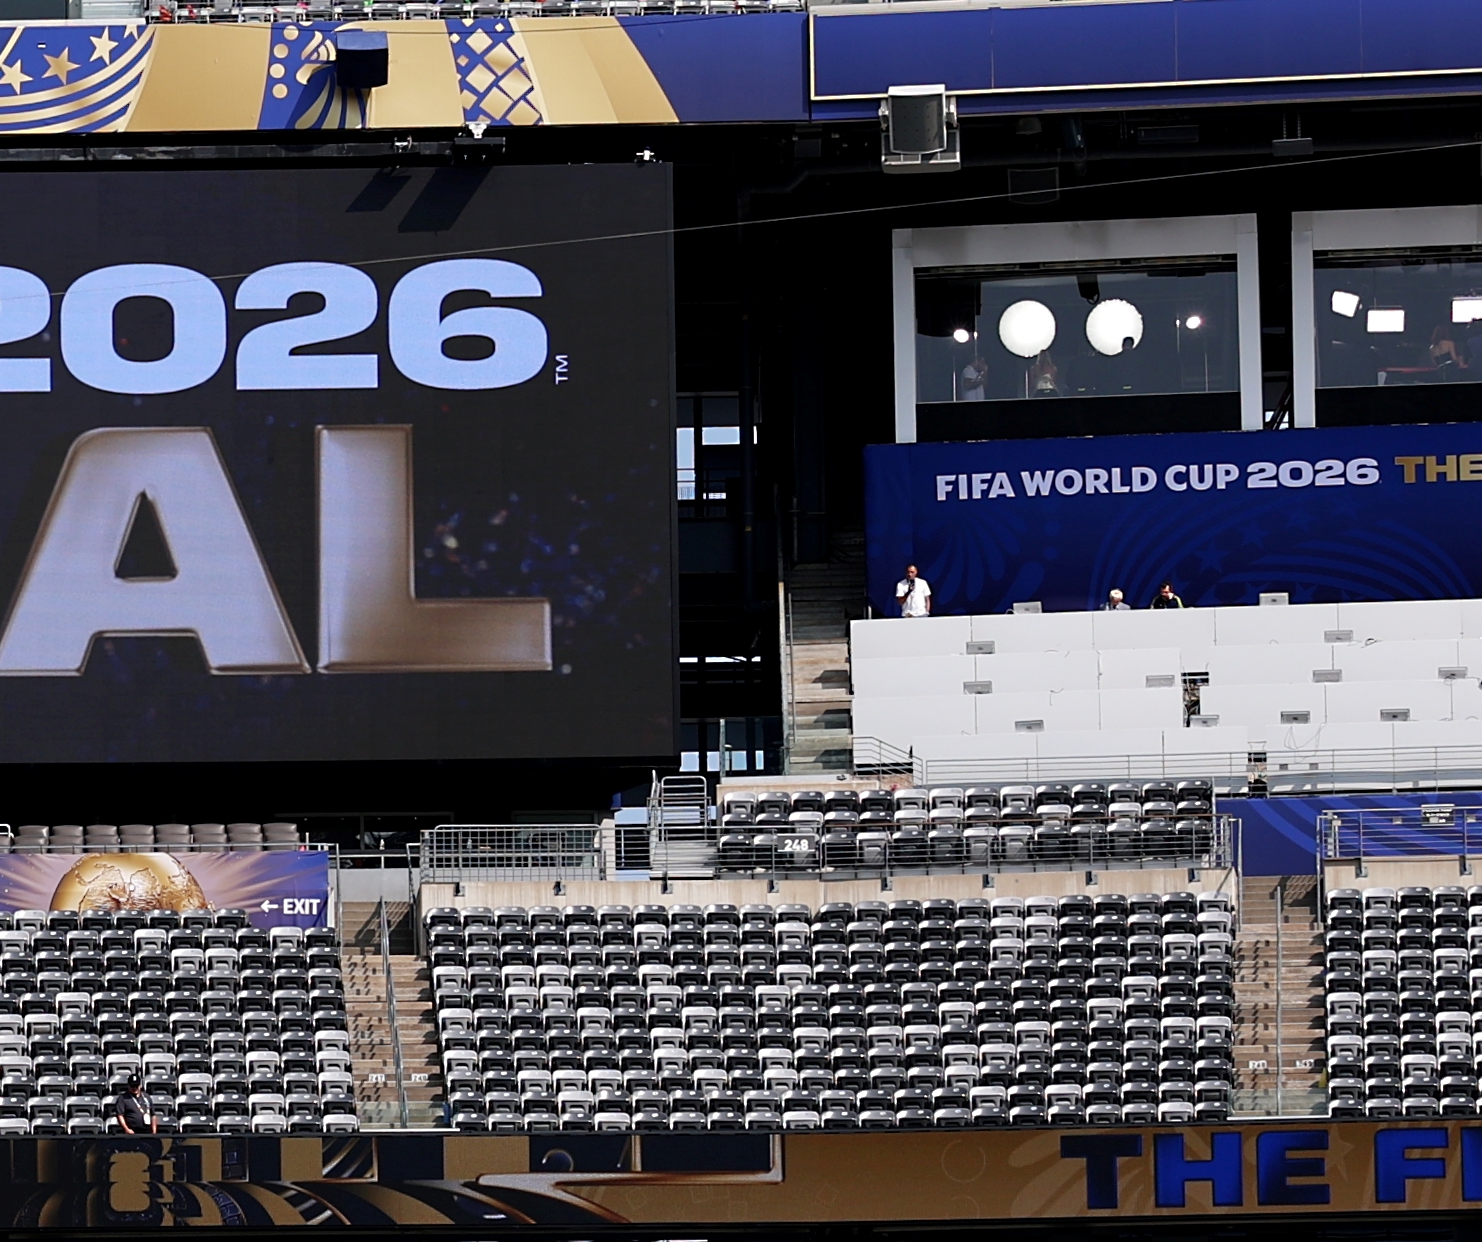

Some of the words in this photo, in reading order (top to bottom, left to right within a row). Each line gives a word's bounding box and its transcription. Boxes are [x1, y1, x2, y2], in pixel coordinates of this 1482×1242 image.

[936, 472, 1016, 501] FIFA
[1021, 467, 1157, 497] WORLD
[1165, 464, 1239, 491] CUP
[1247, 458, 1379, 488] 2026
[1395, 454, 1482, 484] THE
[784, 839, 809, 851] 248
[283, 898, 321, 915] EXIT
[1060, 1129, 1330, 1210] THE
